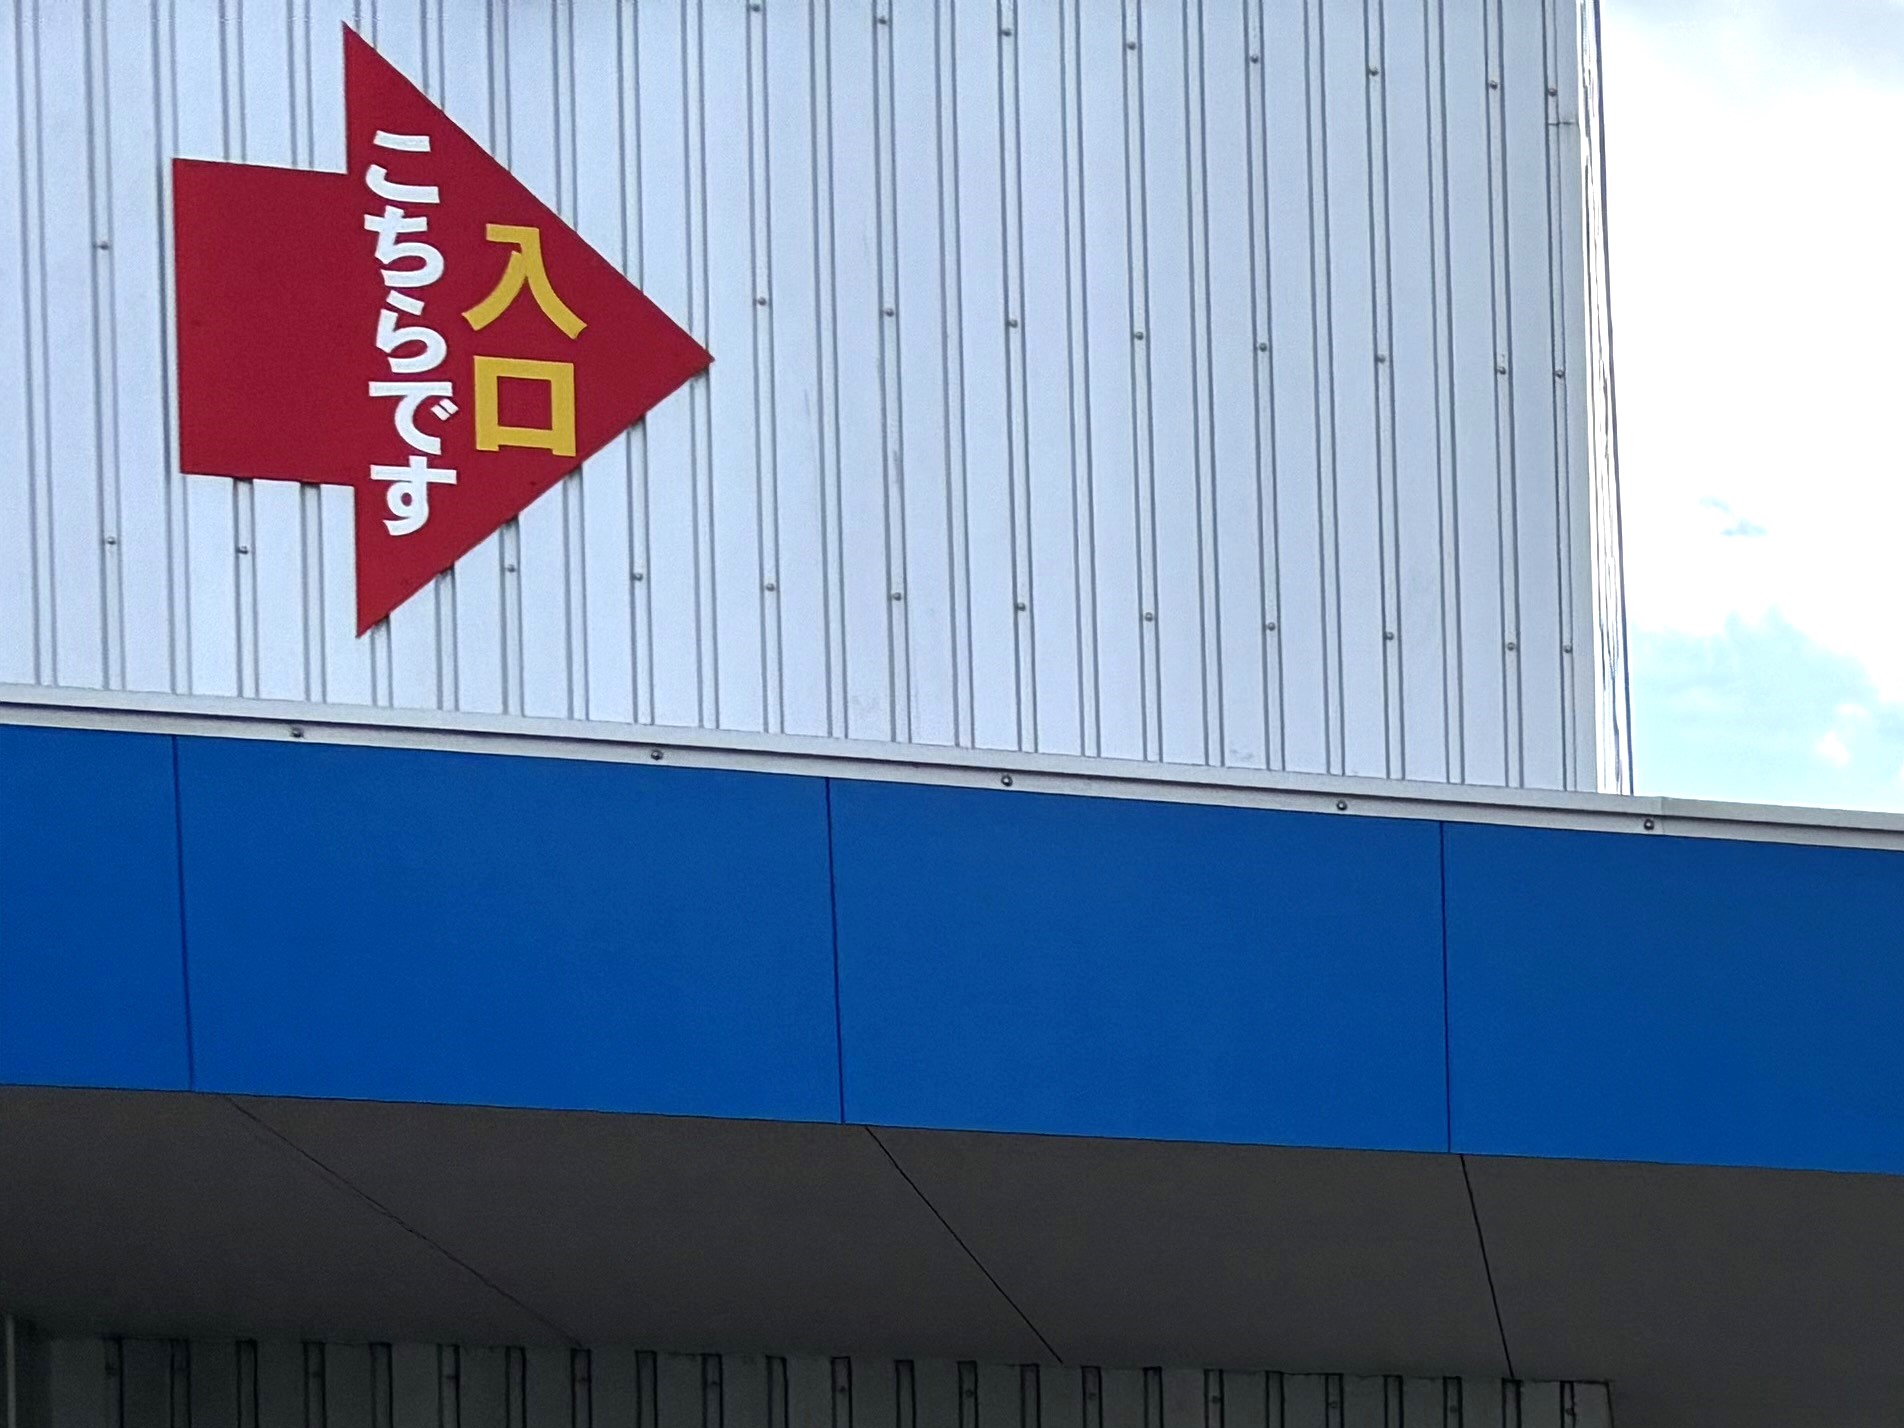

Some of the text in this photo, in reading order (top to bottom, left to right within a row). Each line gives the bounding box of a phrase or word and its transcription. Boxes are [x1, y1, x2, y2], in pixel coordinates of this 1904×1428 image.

[364, 130, 459, 536] こちらです
[462, 222, 587, 457] 入口
